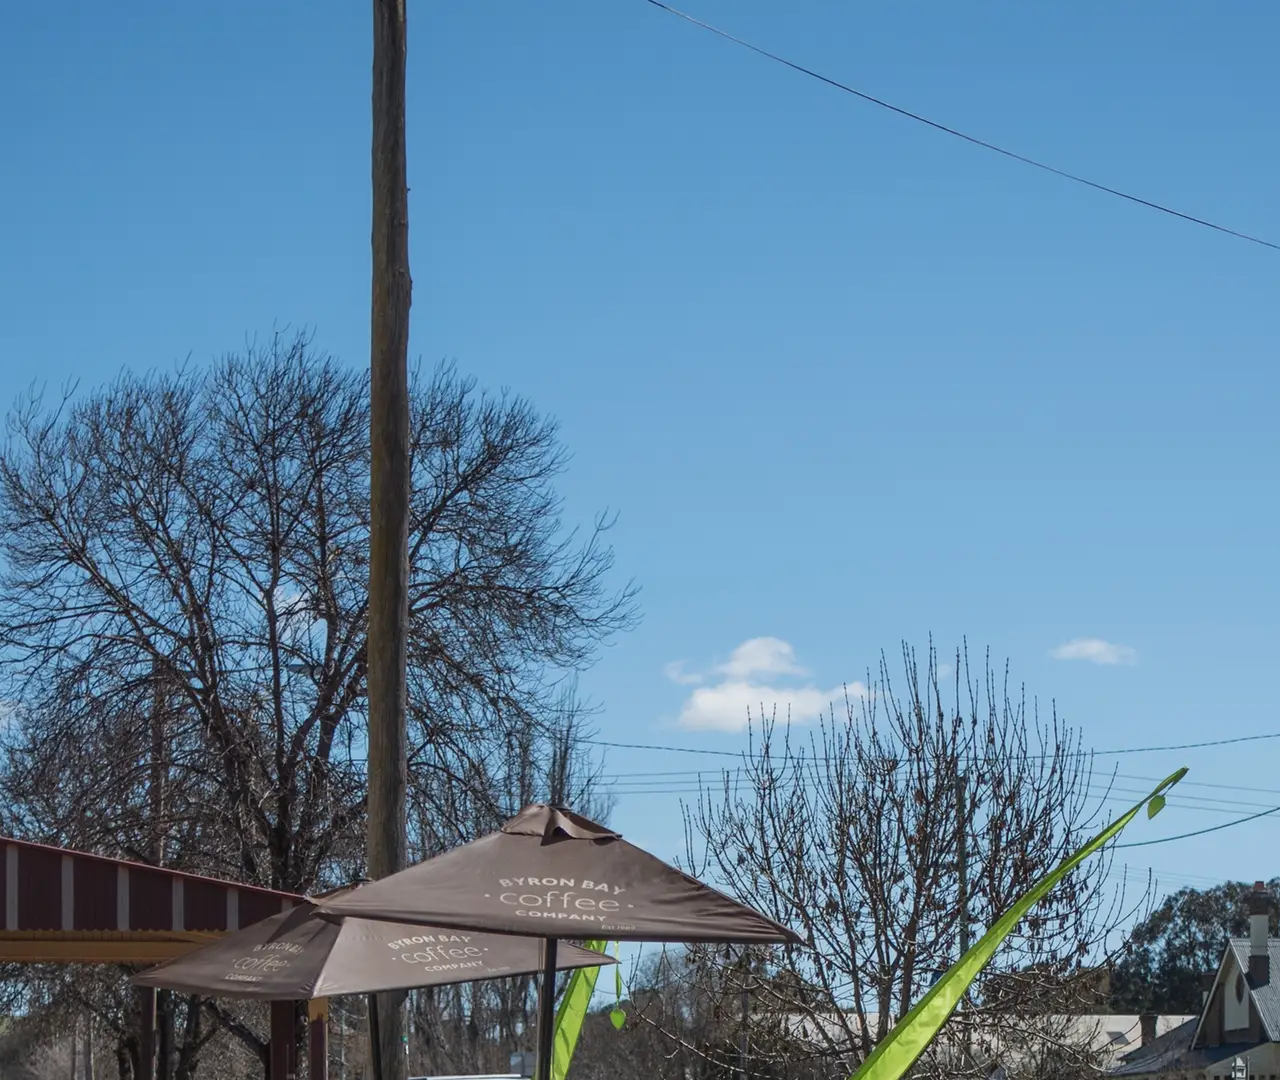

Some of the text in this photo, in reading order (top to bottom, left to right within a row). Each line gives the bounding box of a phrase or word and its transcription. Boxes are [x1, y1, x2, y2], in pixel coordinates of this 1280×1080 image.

[499, 877, 626, 895] BYRON BAY
[500, 891, 619, 911] coffee
[515, 910, 607, 921] COMPANY
[387, 935, 471, 950] BYRON BAY
[401, 945, 482, 964] coffee
[425, 960, 483, 972] COMPANY
